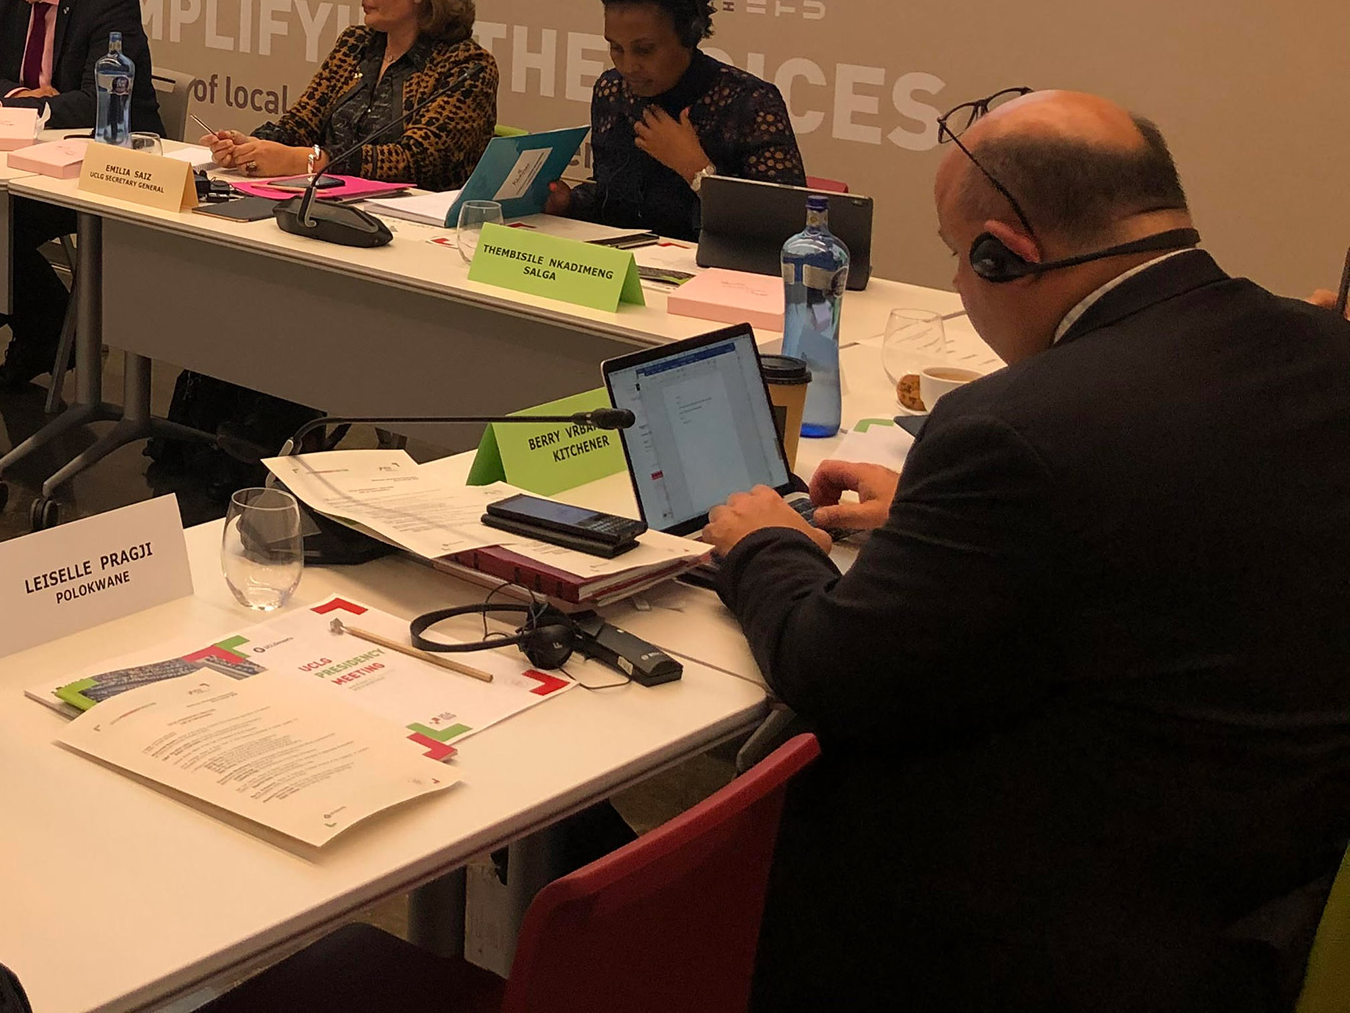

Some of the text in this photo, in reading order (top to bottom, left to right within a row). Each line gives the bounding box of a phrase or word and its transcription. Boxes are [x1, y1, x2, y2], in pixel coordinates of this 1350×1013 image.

[193, 73, 289, 115] of local
[89, 171, 165, 193] UCLG SECRETARY GENERAL
[105, 164, 152, 180] EMILIA SAIZ
[483, 244, 614, 280] THEMBISILE NKADIMENG
[523, 265, 557, 281] SALGA
[528, 430, 560, 450] BERRY
[552, 435, 610, 462] KITCHENER
[24, 542, 153, 595] LEISELLE PRAGJI
[55, 571, 130, 604] POLOKWANE
[298, 657, 332, 672] UCLG
[314, 648, 385, 679] PRESIDENCY
[331, 662, 385, 686] MEETING
